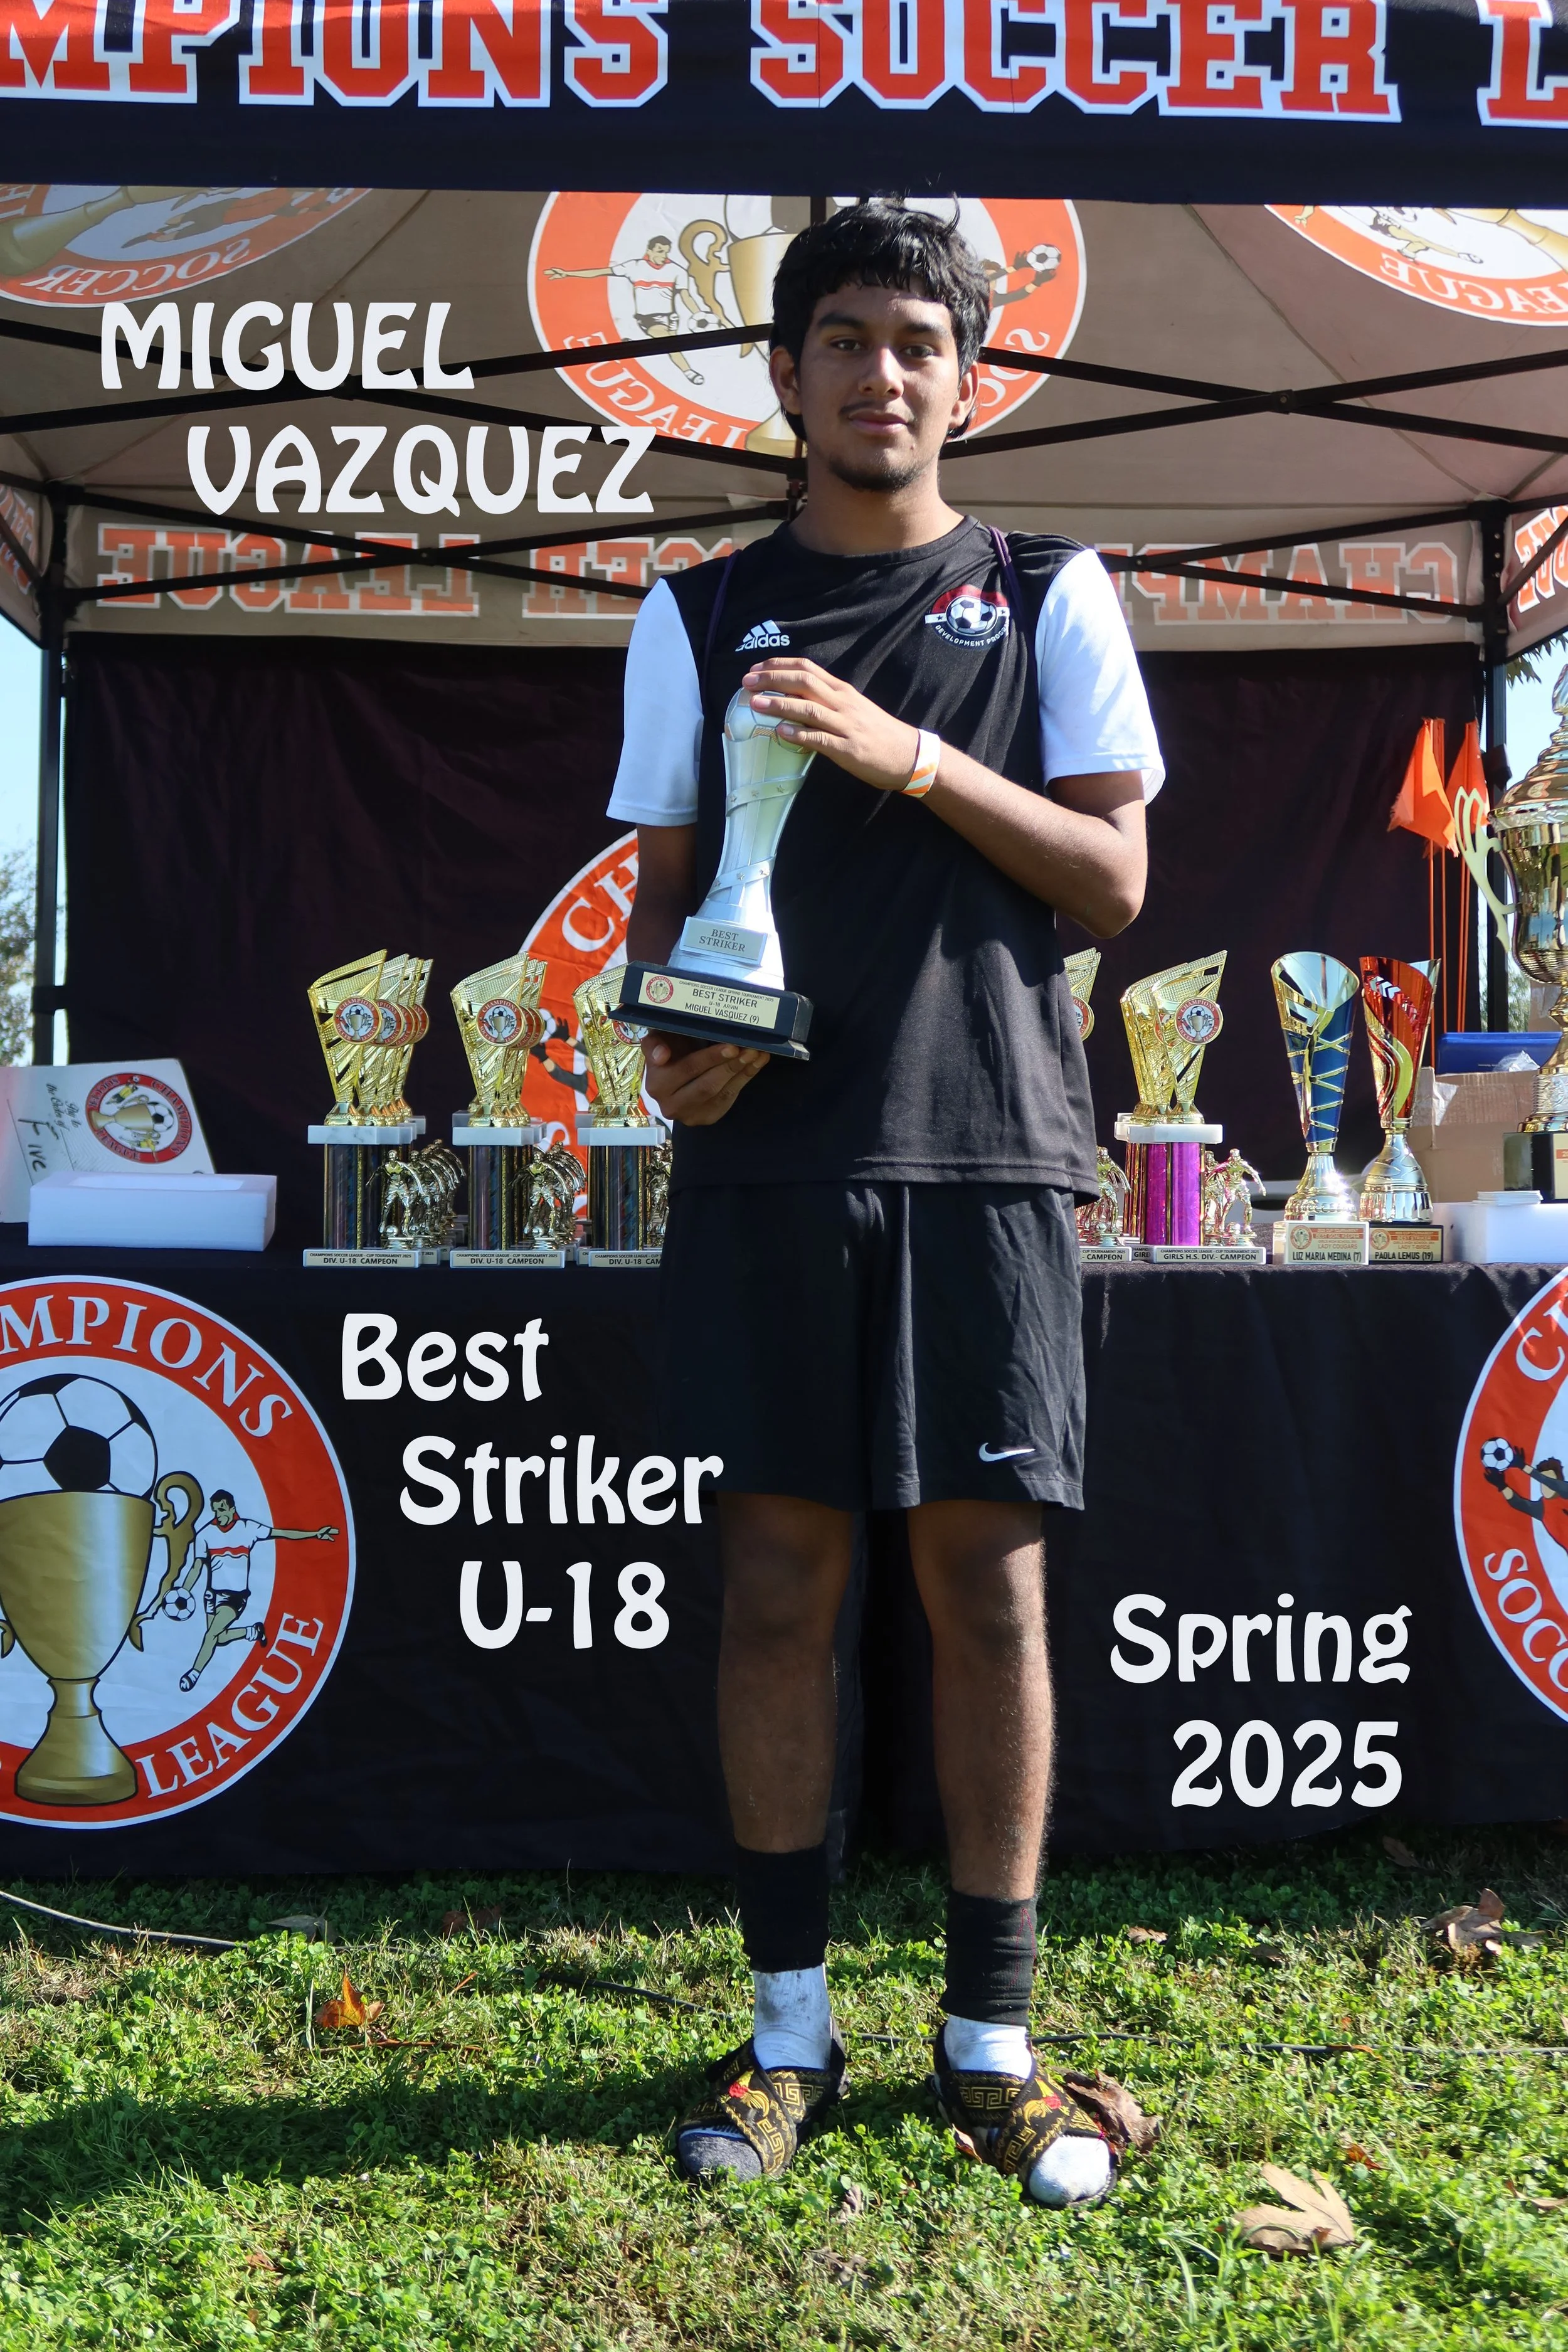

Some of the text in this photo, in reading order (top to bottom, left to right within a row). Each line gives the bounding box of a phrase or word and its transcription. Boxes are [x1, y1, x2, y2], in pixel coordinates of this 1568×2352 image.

[750, 0, 1402, 122] SOCCER
[735, 633, 790, 652] adidas
[935, 625, 985, 647] DEVELOPMENT
[699, 936, 746, 952] STRIKER
[711, 929, 739, 941] BEST
[692, 988, 758, 1008] BEST STRIKER
[1180, 999, 1216, 1012] CHAMPIONS
[685, 1003, 760, 1024] MIGUEL VASQUEZ (9)
[1293, 1252, 1362, 1262] LUZ MARIA MEDINA (7)
[1375, 1251, 1434, 1261] PAOLA LEMUS (19)
[135, 1612, 324, 1799] LEAGUE
